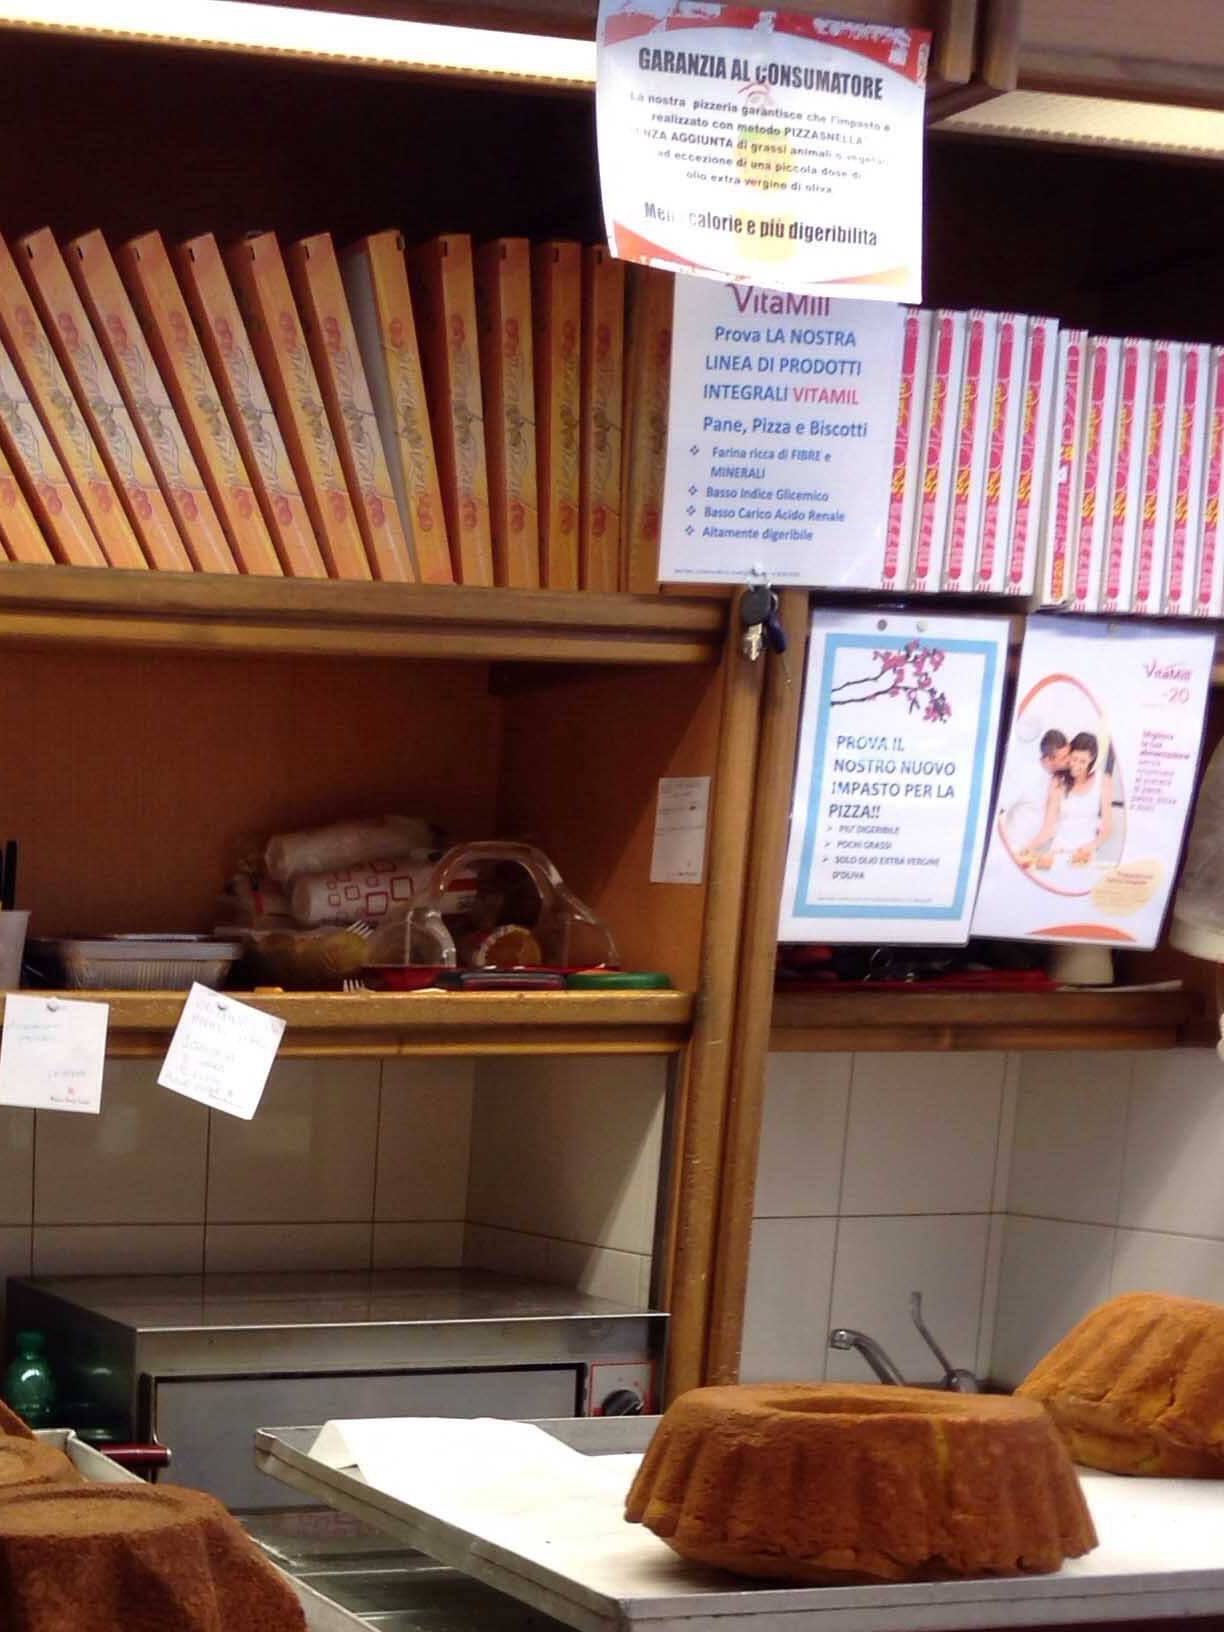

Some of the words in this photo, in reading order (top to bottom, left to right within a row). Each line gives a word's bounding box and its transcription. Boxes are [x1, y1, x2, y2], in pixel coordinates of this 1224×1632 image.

[638, 48, 726, 80] GARANZIA
[731, 59, 750, 80] AL
[755, 63, 884, 101] CONSUMATORE
[648, 95, 687, 108] nostra
[692, 99, 739, 113] pizzeria
[741, 105, 803, 118] garantisce
[806, 111, 827, 123] che
[651, 113, 710, 128] realizzato
[712, 120, 734, 131] con
[737, 122, 781, 136] metodo
[670, 131, 734, 149] AGGIUNTA
[736, 140, 748, 150] di
[750, 143, 787, 154] grassi
[673, 153, 734, 166] eccezione
[735, 157, 748, 168] di
[750, 160, 772, 171] una
[710, 175, 742, 185] extra
[743, 177, 788, 191] vergine
[688, 211, 744, 235] calorie
[745, 220, 758, 236] e
[714, 326, 761, 343] Prova
[766, 328, 786, 344] LA
[789, 329, 857, 348] NOSTRA
[705, 355, 753, 371] LINEA
[757, 357, 774, 373] DI
[779, 358, 862, 377] PRODOTTI
[703, 384, 789, 402] INTEGRALI
[703, 416, 747, 435] Pane,
[752, 418, 792, 434] Pizza
[796, 423, 806, 435] e
[809, 420, 868, 438] Biscotti
[712, 447, 747, 459] Farina
[749, 448, 775, 460] ricca
[777, 448, 789, 461] di
[710, 466, 766, 480] MINERALI
[706, 486, 738, 499] Basso
[739, 488, 773, 501] Indice
[775, 489, 829, 502] Glicemico
[704, 506, 736, 519] Basso
[737, 507, 772, 520] Carico
[774, 509, 806, 522] Acido
[702, 526, 760, 540] Altamente
[762, 528, 814, 543] digeribile
[836, 734, 888, 751] PROVA
[891, 736, 905, 752] IL
[833, 758, 896, 774] NOSTRO
[900, 760, 956, 777] NUOVO
[831, 780, 901, 797] IMPASTO
[904, 783, 932, 798] PER
[936, 784, 955, 799] LA
[827, 803, 881, 820] PIZZA!!
